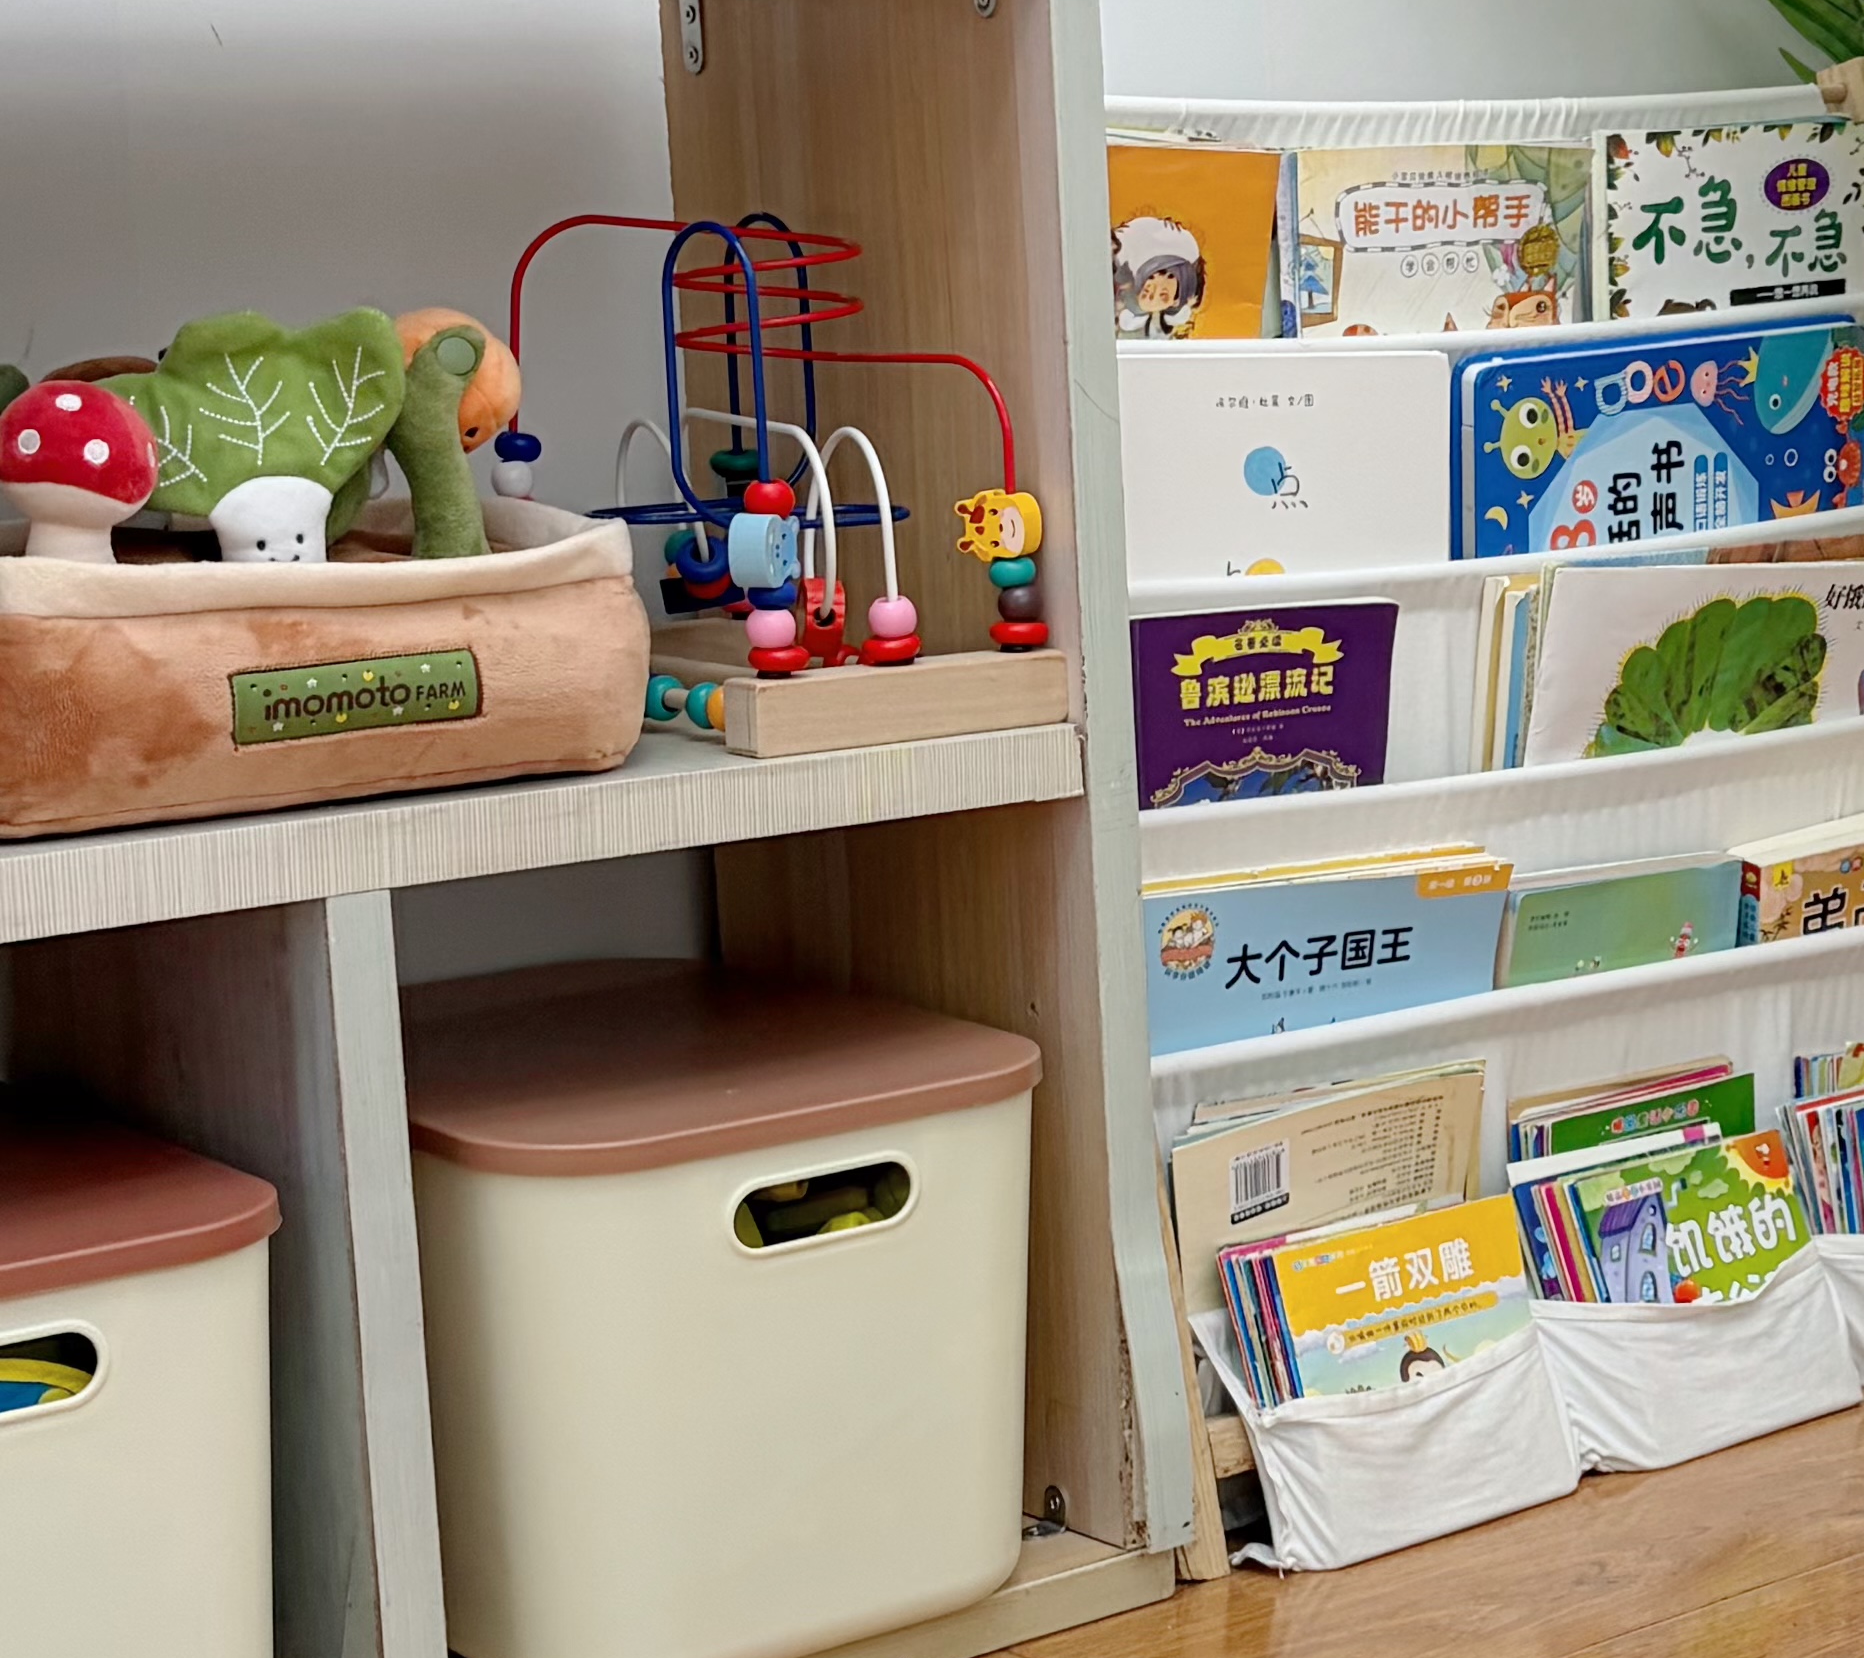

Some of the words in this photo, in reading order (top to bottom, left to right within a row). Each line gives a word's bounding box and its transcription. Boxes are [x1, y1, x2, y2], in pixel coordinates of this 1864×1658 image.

[1353, 194, 1532, 238] 能干的小帮手
[264, 675, 412, 722] imomoto
[415, 681, 467, 702] FARM
[1180, 664, 1334, 710] 鲁滨逊漂流记
[1183, 718, 1201, 728] The
[1225, 926, 1414, 989] 大个子国王
[1665, 1193, 1798, 1278] 饥饿的
[1335, 1237, 1475, 1303] 一箭双雕
